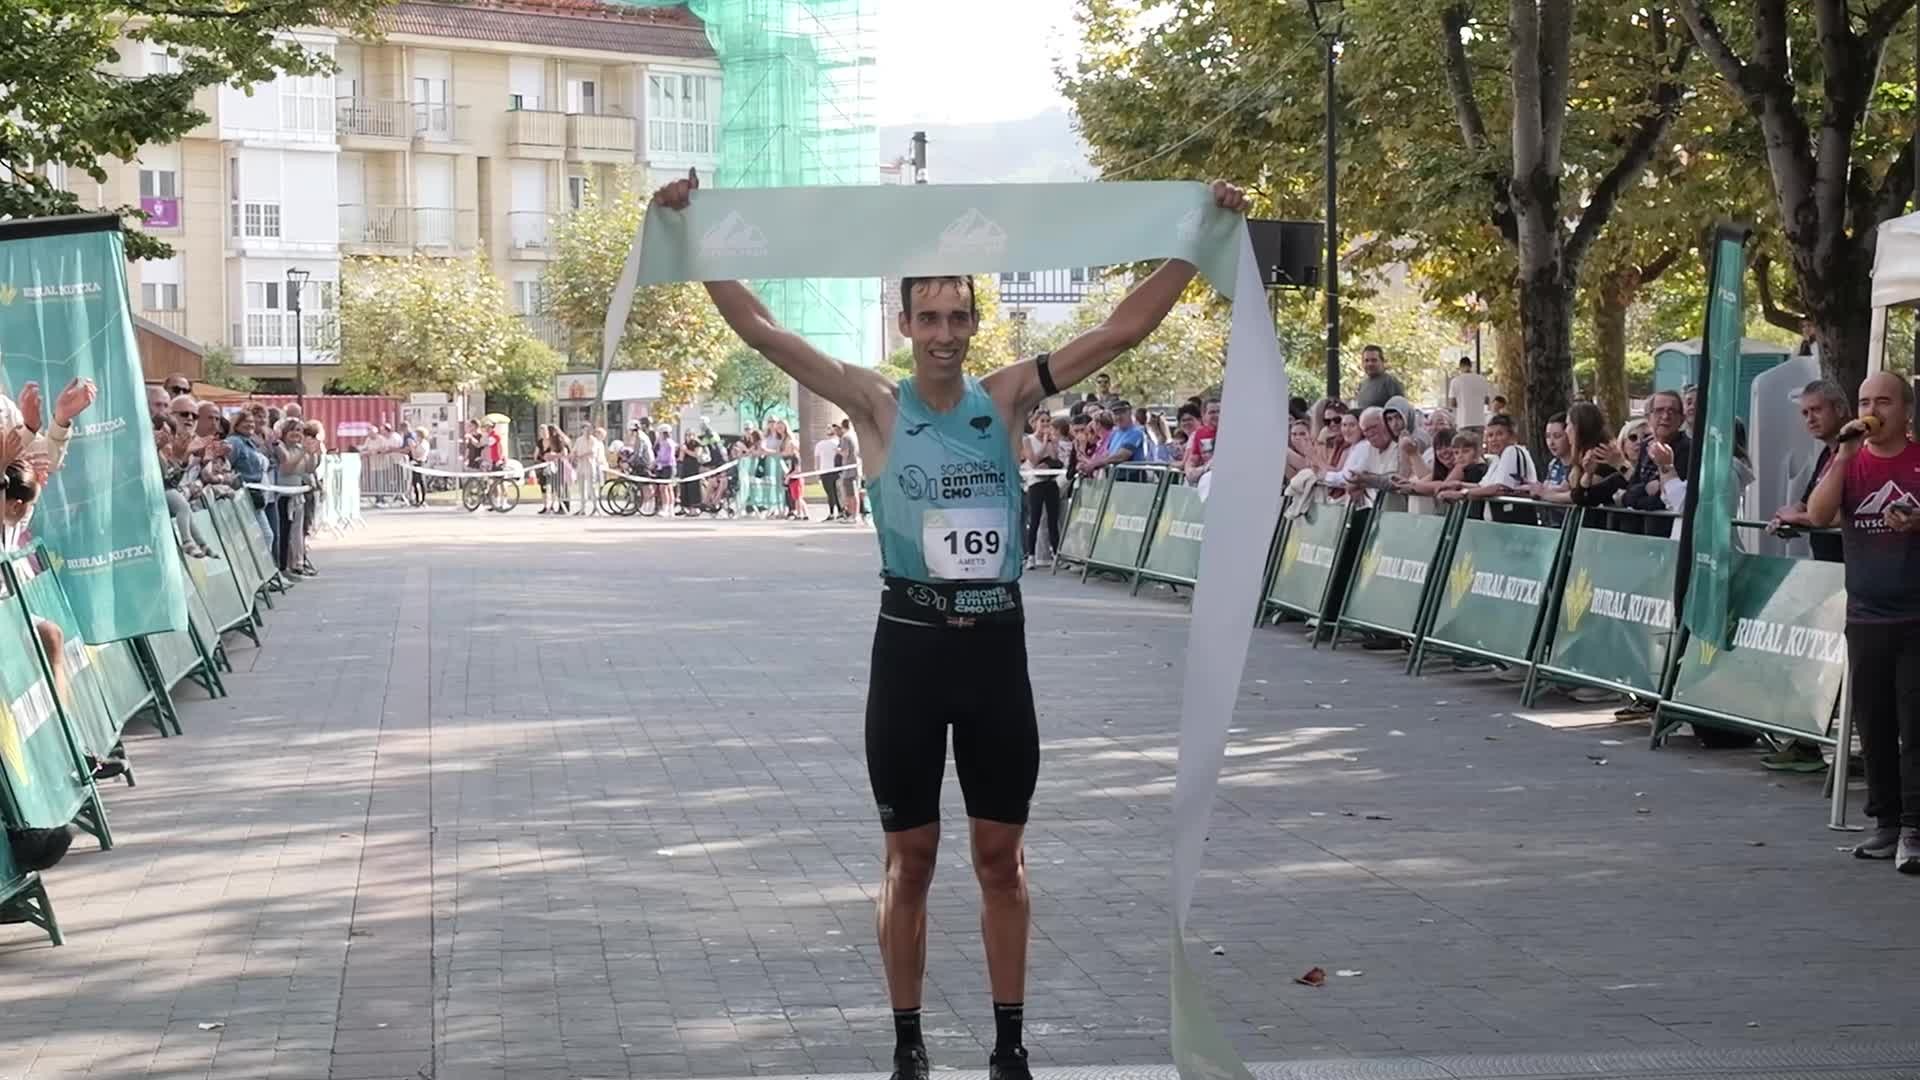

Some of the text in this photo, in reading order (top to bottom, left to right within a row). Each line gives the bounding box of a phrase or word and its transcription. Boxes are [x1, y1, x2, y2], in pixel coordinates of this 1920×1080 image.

[108, 544, 153, 562] KUTXA
[944, 530, 1000, 555] 169
[1502, 576, 1541, 606] KUTXA
[1590, 587, 1674, 628] RURAL KUTXA
[1732, 617, 1848, 665] RURAL KUTXA
